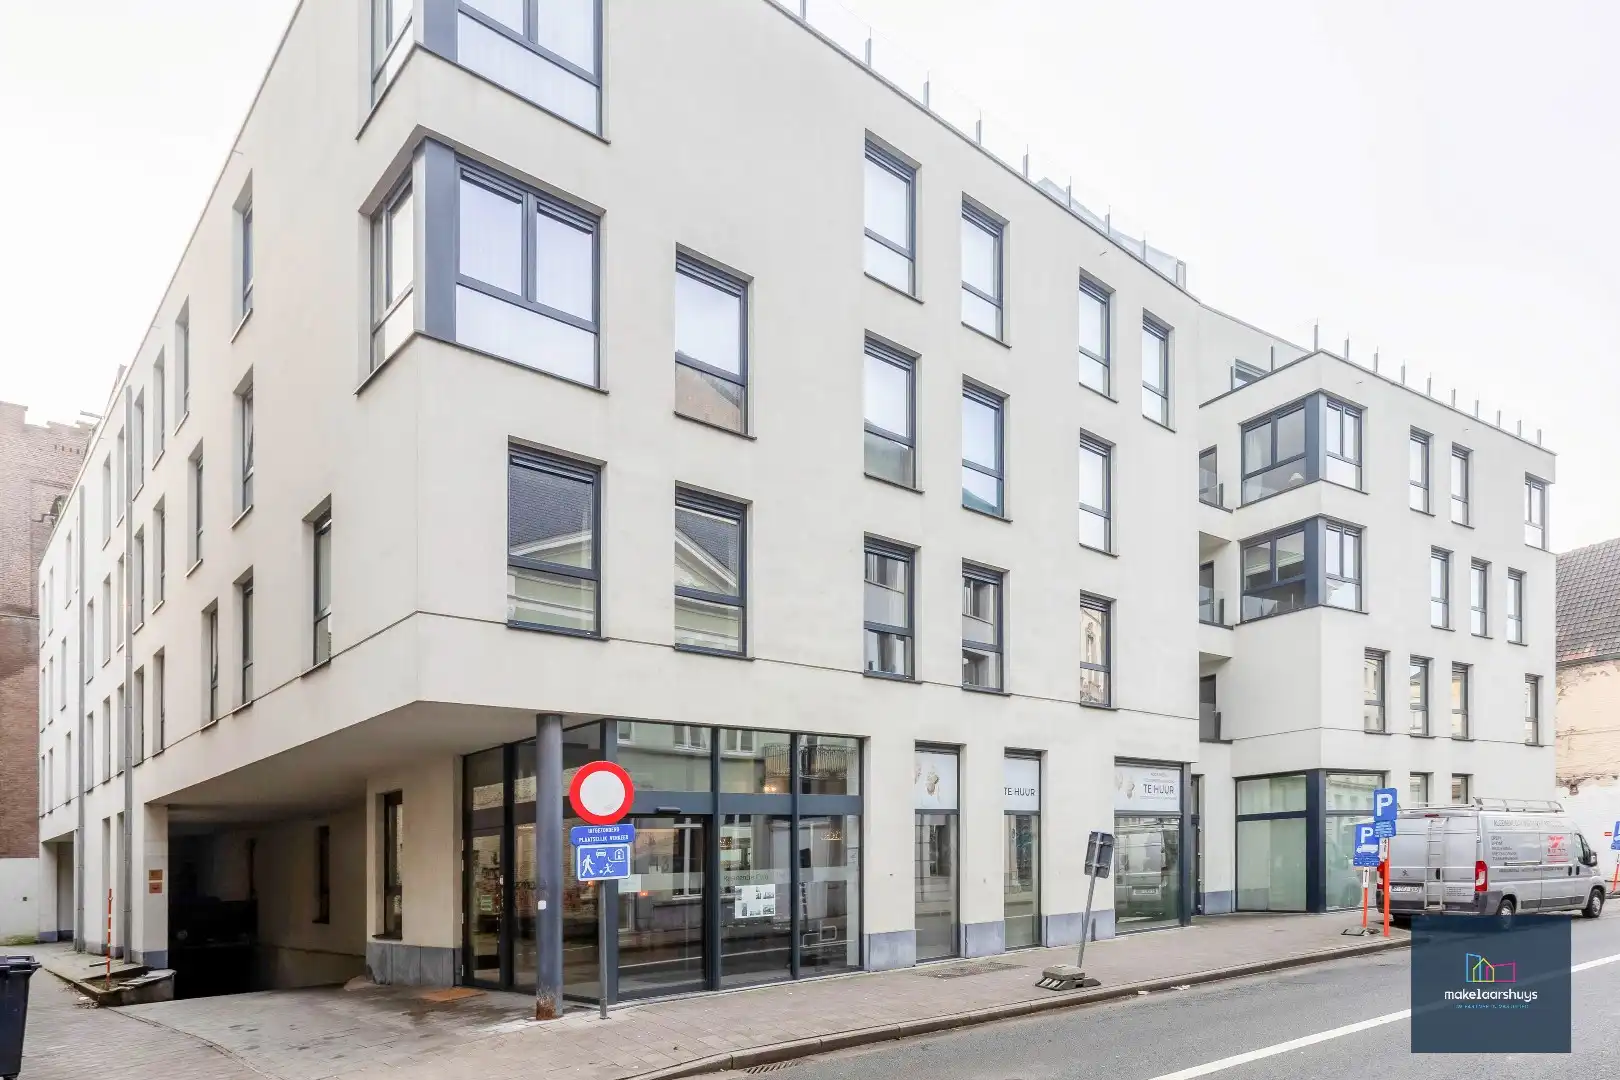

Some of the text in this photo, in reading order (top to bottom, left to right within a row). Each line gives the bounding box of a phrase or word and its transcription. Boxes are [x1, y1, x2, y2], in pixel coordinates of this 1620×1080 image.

[1003, 786, 1036, 797] TE HUUR
[1142, 783, 1175, 795] TE HUUR
[1376, 793, 1393, 817] P
[1360, 826, 1374, 844] P
